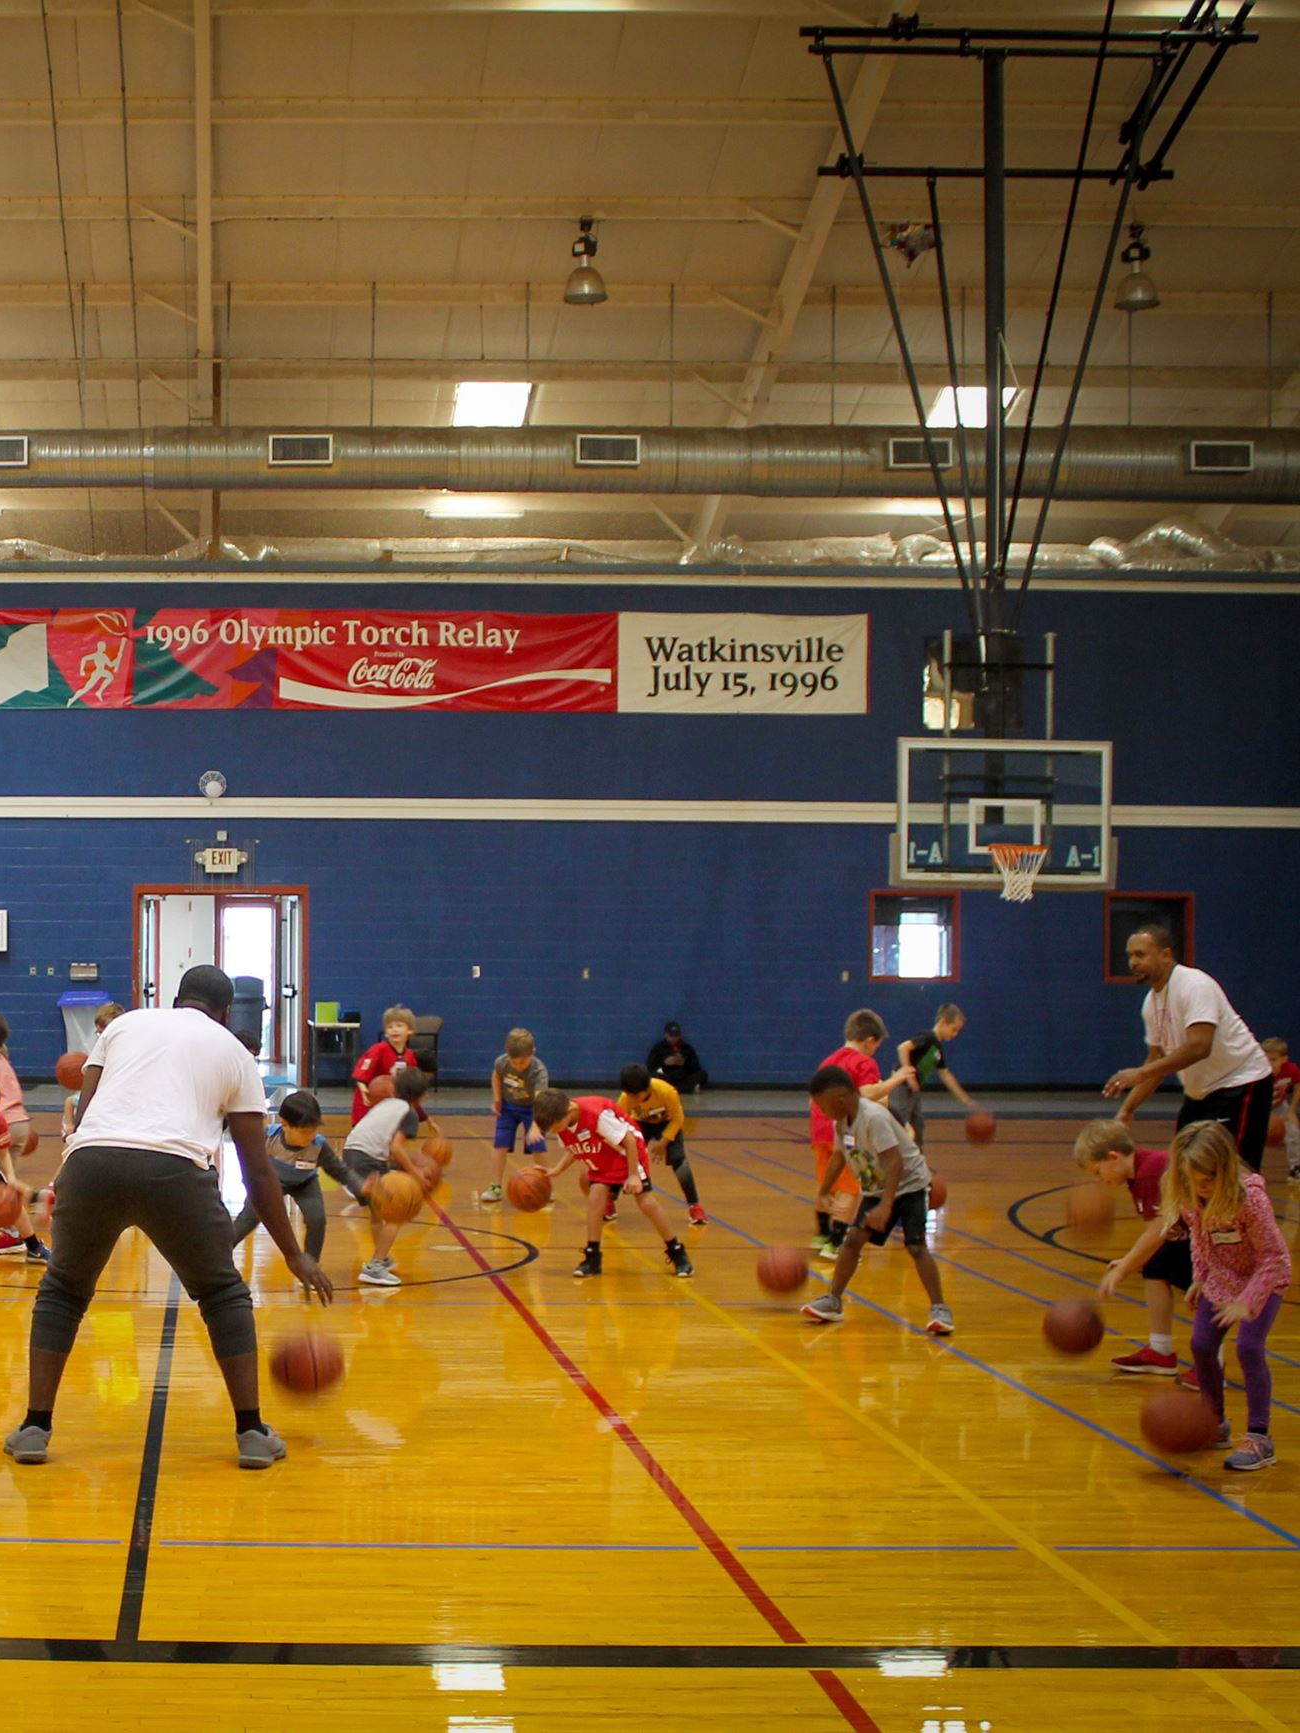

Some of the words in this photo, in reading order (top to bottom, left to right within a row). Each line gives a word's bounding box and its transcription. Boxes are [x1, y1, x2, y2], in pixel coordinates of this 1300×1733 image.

[146, 619, 208, 651] 1996
[219, 617, 335, 652] Olympic
[341, 619, 429, 647] Torch
[438, 621, 520, 654] Relay
[644, 635, 844, 664] Watkinsville
[347, 656, 438, 689] Coca-Cola
[646, 664, 712, 698] July
[721, 672, 756, 698] 15,
[767, 665, 839, 698] 1996
[211, 850, 232, 866] EXIT
[1065, 845, 1100, 868] A-1
